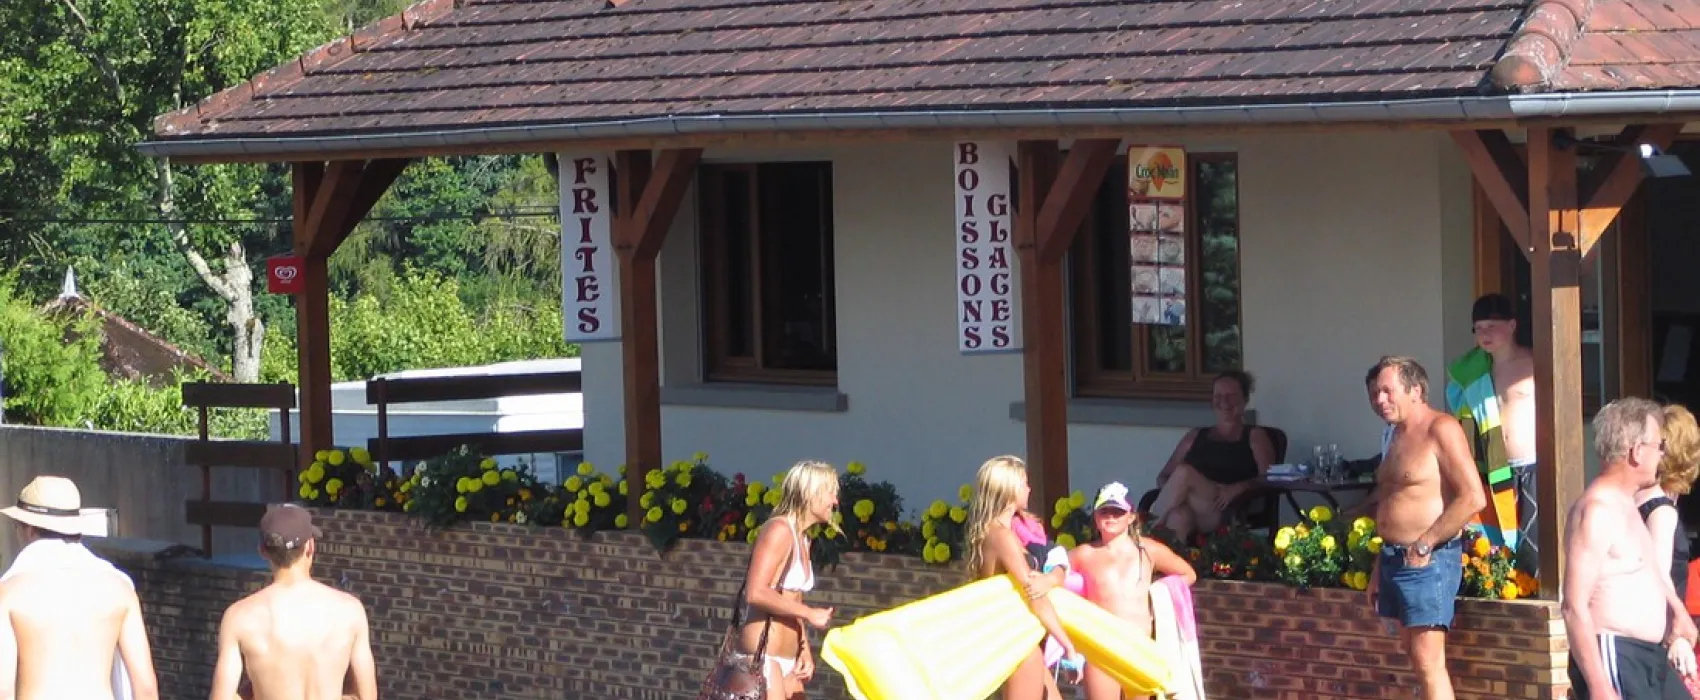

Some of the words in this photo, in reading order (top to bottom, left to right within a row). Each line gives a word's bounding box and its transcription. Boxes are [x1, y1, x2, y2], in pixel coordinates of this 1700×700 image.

[572, 157, 600, 333] FRITES
[958, 142, 982, 349] BOISSONS
[987, 193, 1010, 348] GLACES
